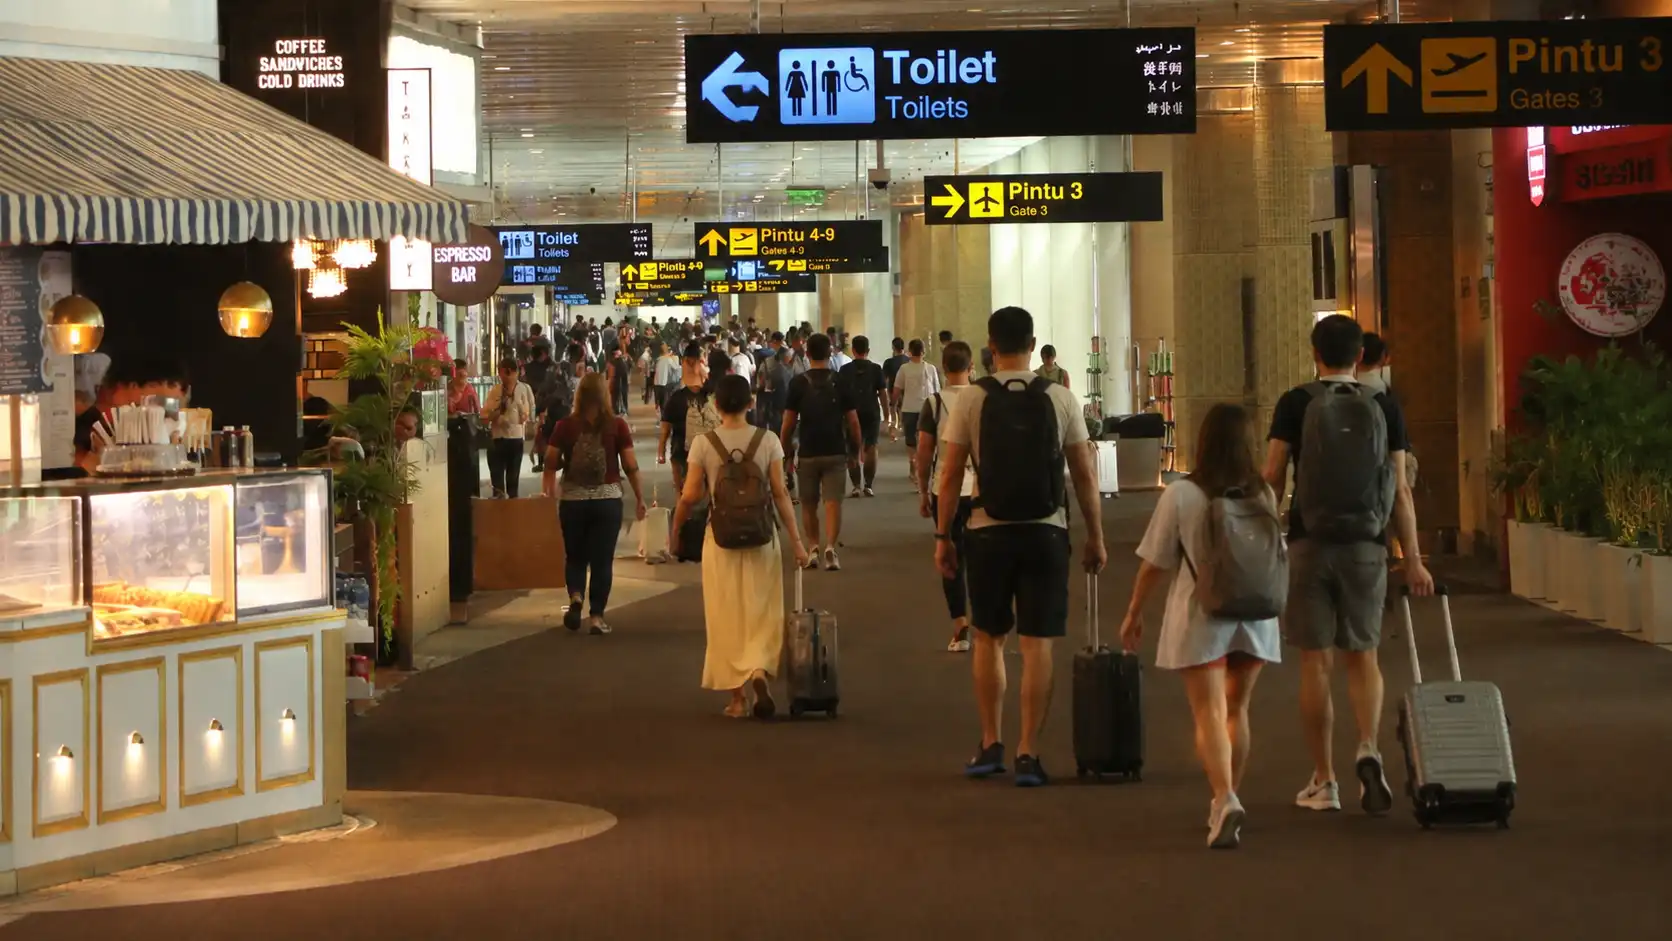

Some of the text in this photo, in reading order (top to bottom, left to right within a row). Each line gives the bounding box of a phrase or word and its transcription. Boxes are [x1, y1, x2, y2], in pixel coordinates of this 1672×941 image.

[275, 39, 326, 54] COFFEE
[1508, 36, 1663, 75] Pintu 3
[883, 49, 997, 85] Toilet
[258, 73, 345, 89] COLD DRINKS
[1510, 87, 1604, 110] Gates 3
[885, 95, 969, 119] Toilets
[1009, 182, 1083, 200] Pintu 3
[1009, 205, 1048, 216] Gate 3
[537, 232, 579, 245] Toilet
[761, 228, 834, 242] Pintu 4-9
[434, 246, 491, 263] ESPRESSO
[451, 266, 476, 282] BAR
